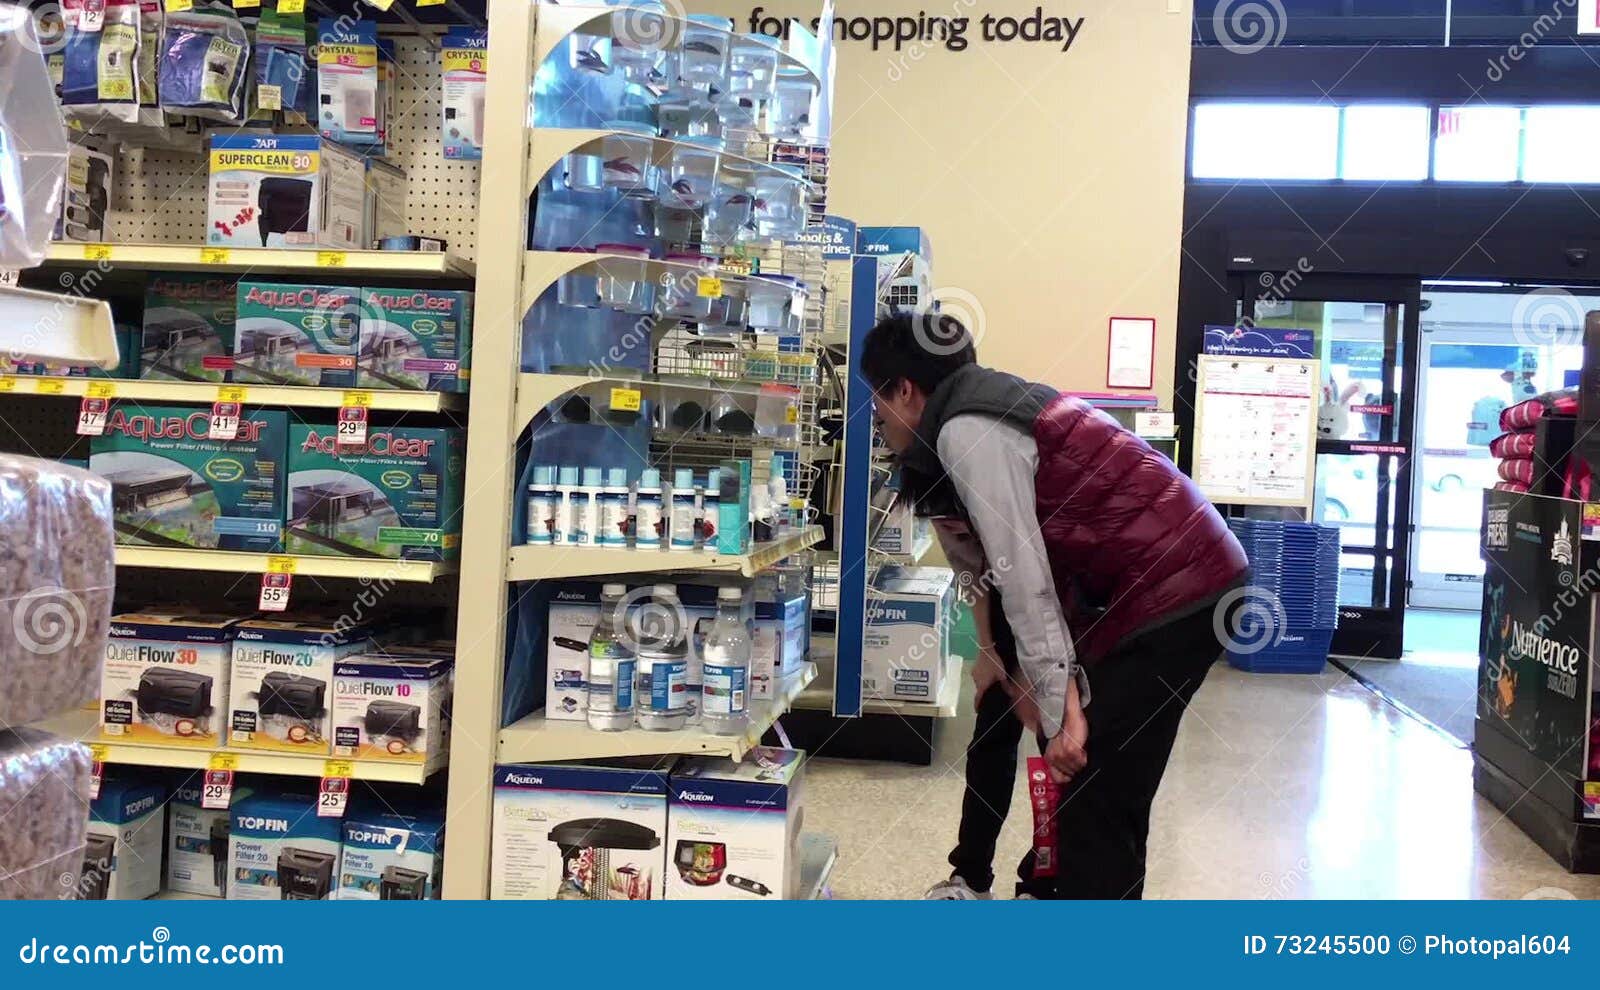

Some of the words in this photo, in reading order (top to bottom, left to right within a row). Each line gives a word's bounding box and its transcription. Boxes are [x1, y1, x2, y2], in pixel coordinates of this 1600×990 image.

[749, 8, 791, 41] for
[980, 6, 1085, 52] today
[341, 33, 359, 43] API
[469, 38, 486, 47] API
[446, 50, 484, 60] CRYSTAL
[1438, 111, 1461, 137] XIT
[258, 138, 278, 148] API
[218, 154, 289, 166] SUPERCLEAN
[293, 156, 310, 168] 30
[244, 287, 350, 309] AquaClear
[367, 291, 456, 311] AquaClear
[338, 358, 353, 367] 30
[443, 362, 457, 371] 20
[150, 442, 174, 450] Power
[255, 523, 277, 533] 110
[423, 533, 438, 542] 70
[1511, 620, 1579, 675] Nutrience
[175, 648, 198, 665] 30
[296, 652, 313, 667] 20
[396, 684, 411, 697] 10
[504, 772, 543, 784] AQUEON
[679, 790, 714, 802] AQUEON
[235, 841, 262, 852] Power
[235, 851, 256, 861] Filter
[257, 853, 268, 862] 20
[344, 851, 369, 862] Power
[344, 859, 363, 868] Filter
